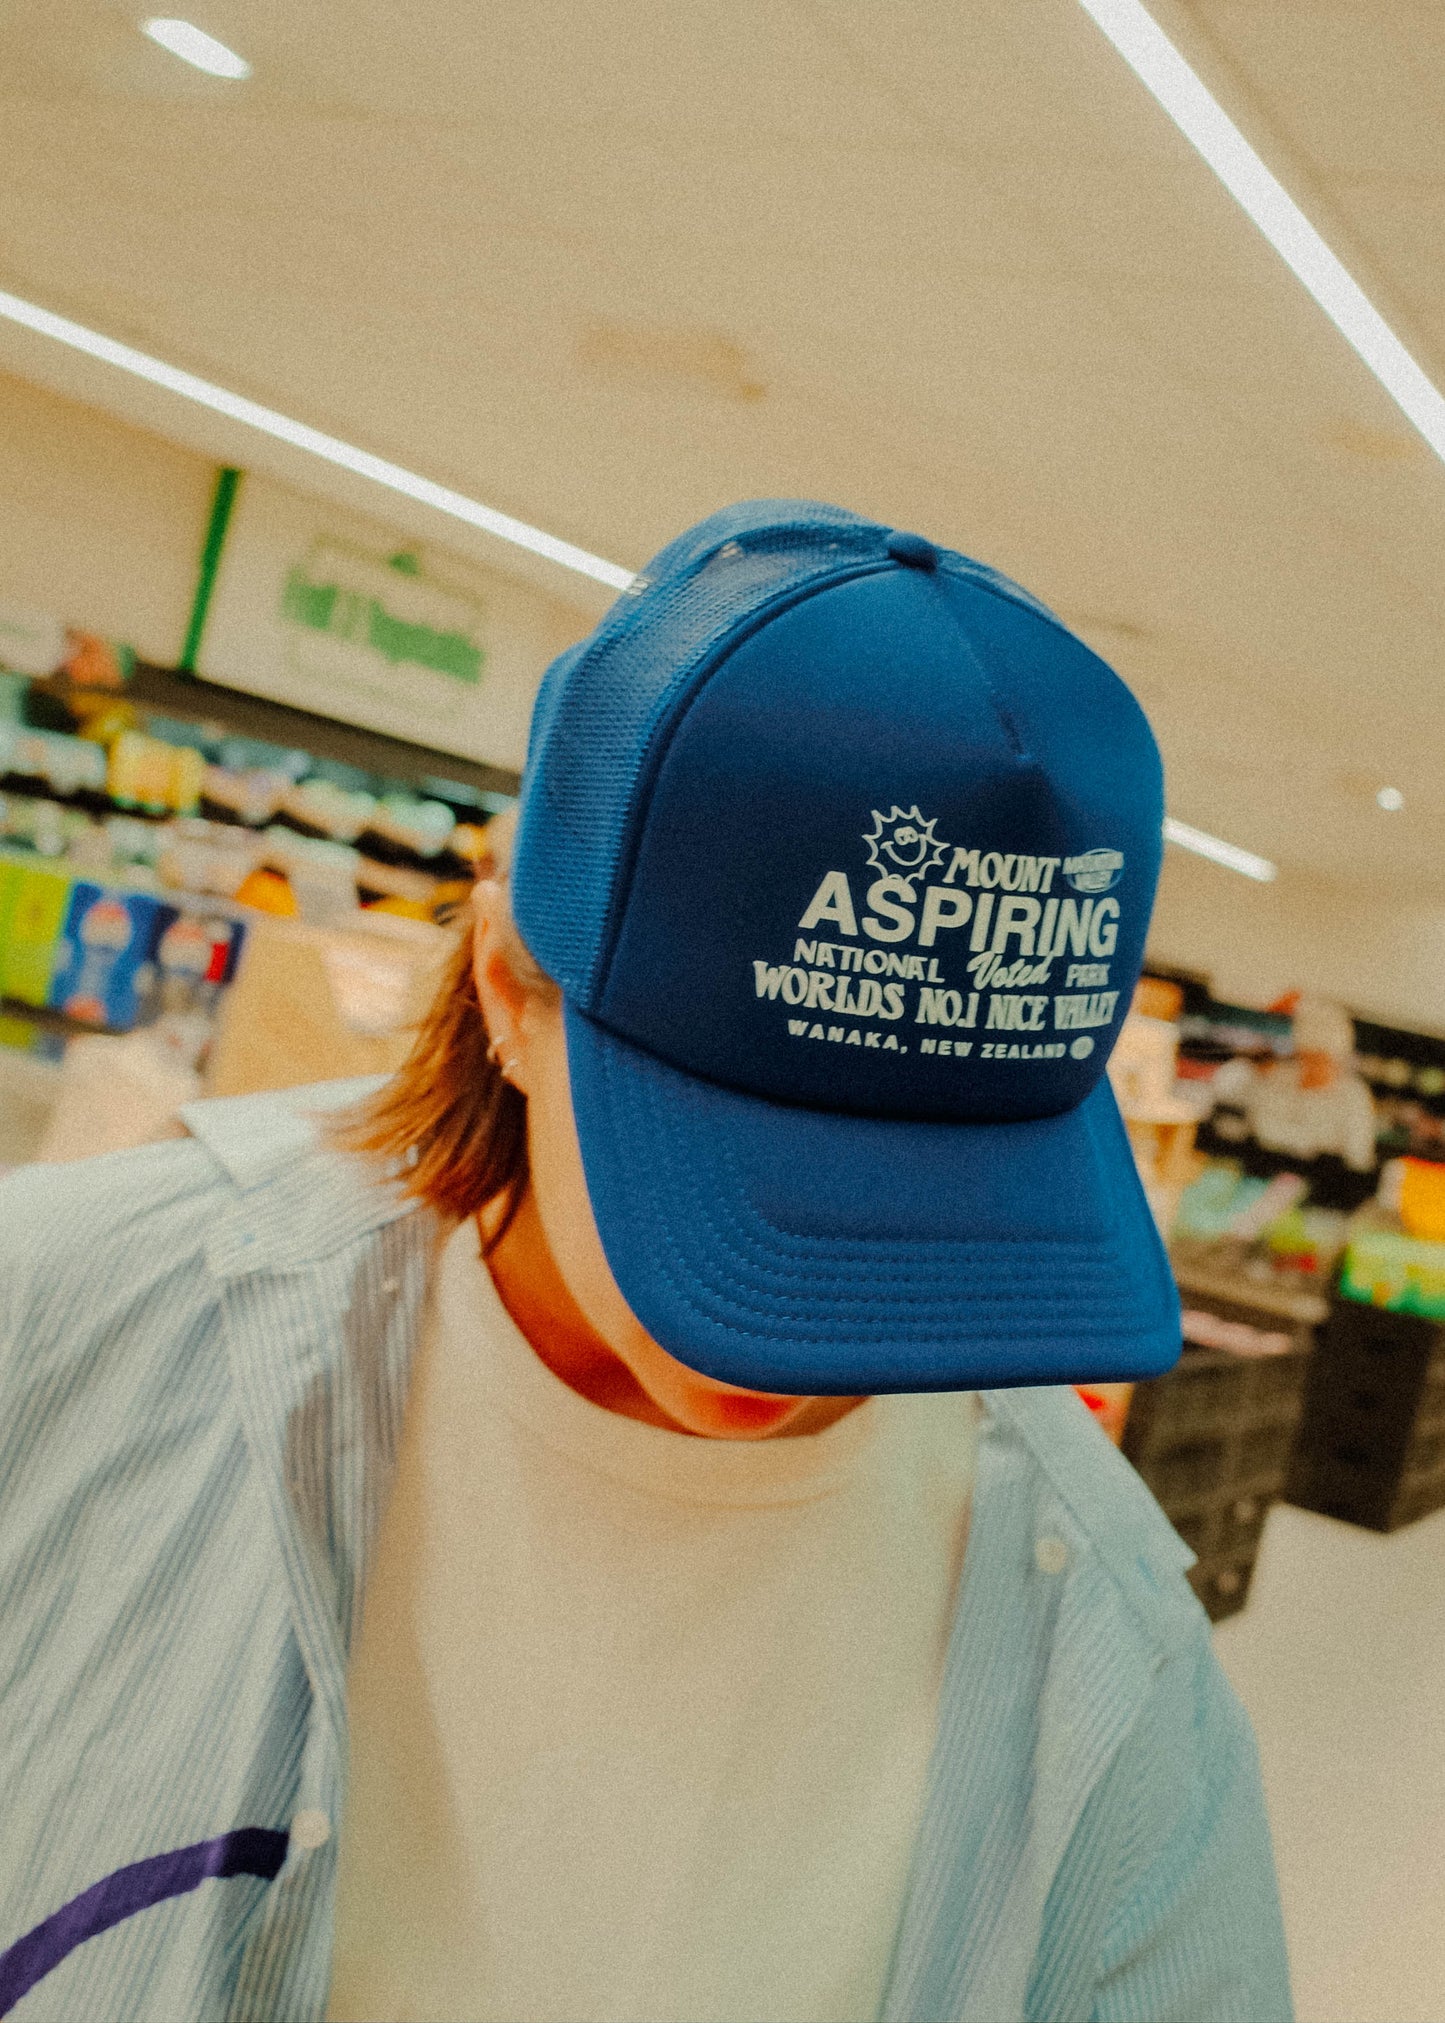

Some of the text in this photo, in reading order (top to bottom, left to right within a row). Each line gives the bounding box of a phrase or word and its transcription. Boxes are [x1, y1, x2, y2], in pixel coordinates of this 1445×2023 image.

[942, 847, 1061, 893] MOUNT
[798, 870, 1120, 957] ASPIRING
[793, 938, 945, 983] NATIONAL
[966, 950, 1052, 990] Voted
[753, 960, 1120, 1031] WORLDS NO.1 NICE VALLEY
[788, 1019, 1067, 1059] WANAKA, NEW ZEALAND
